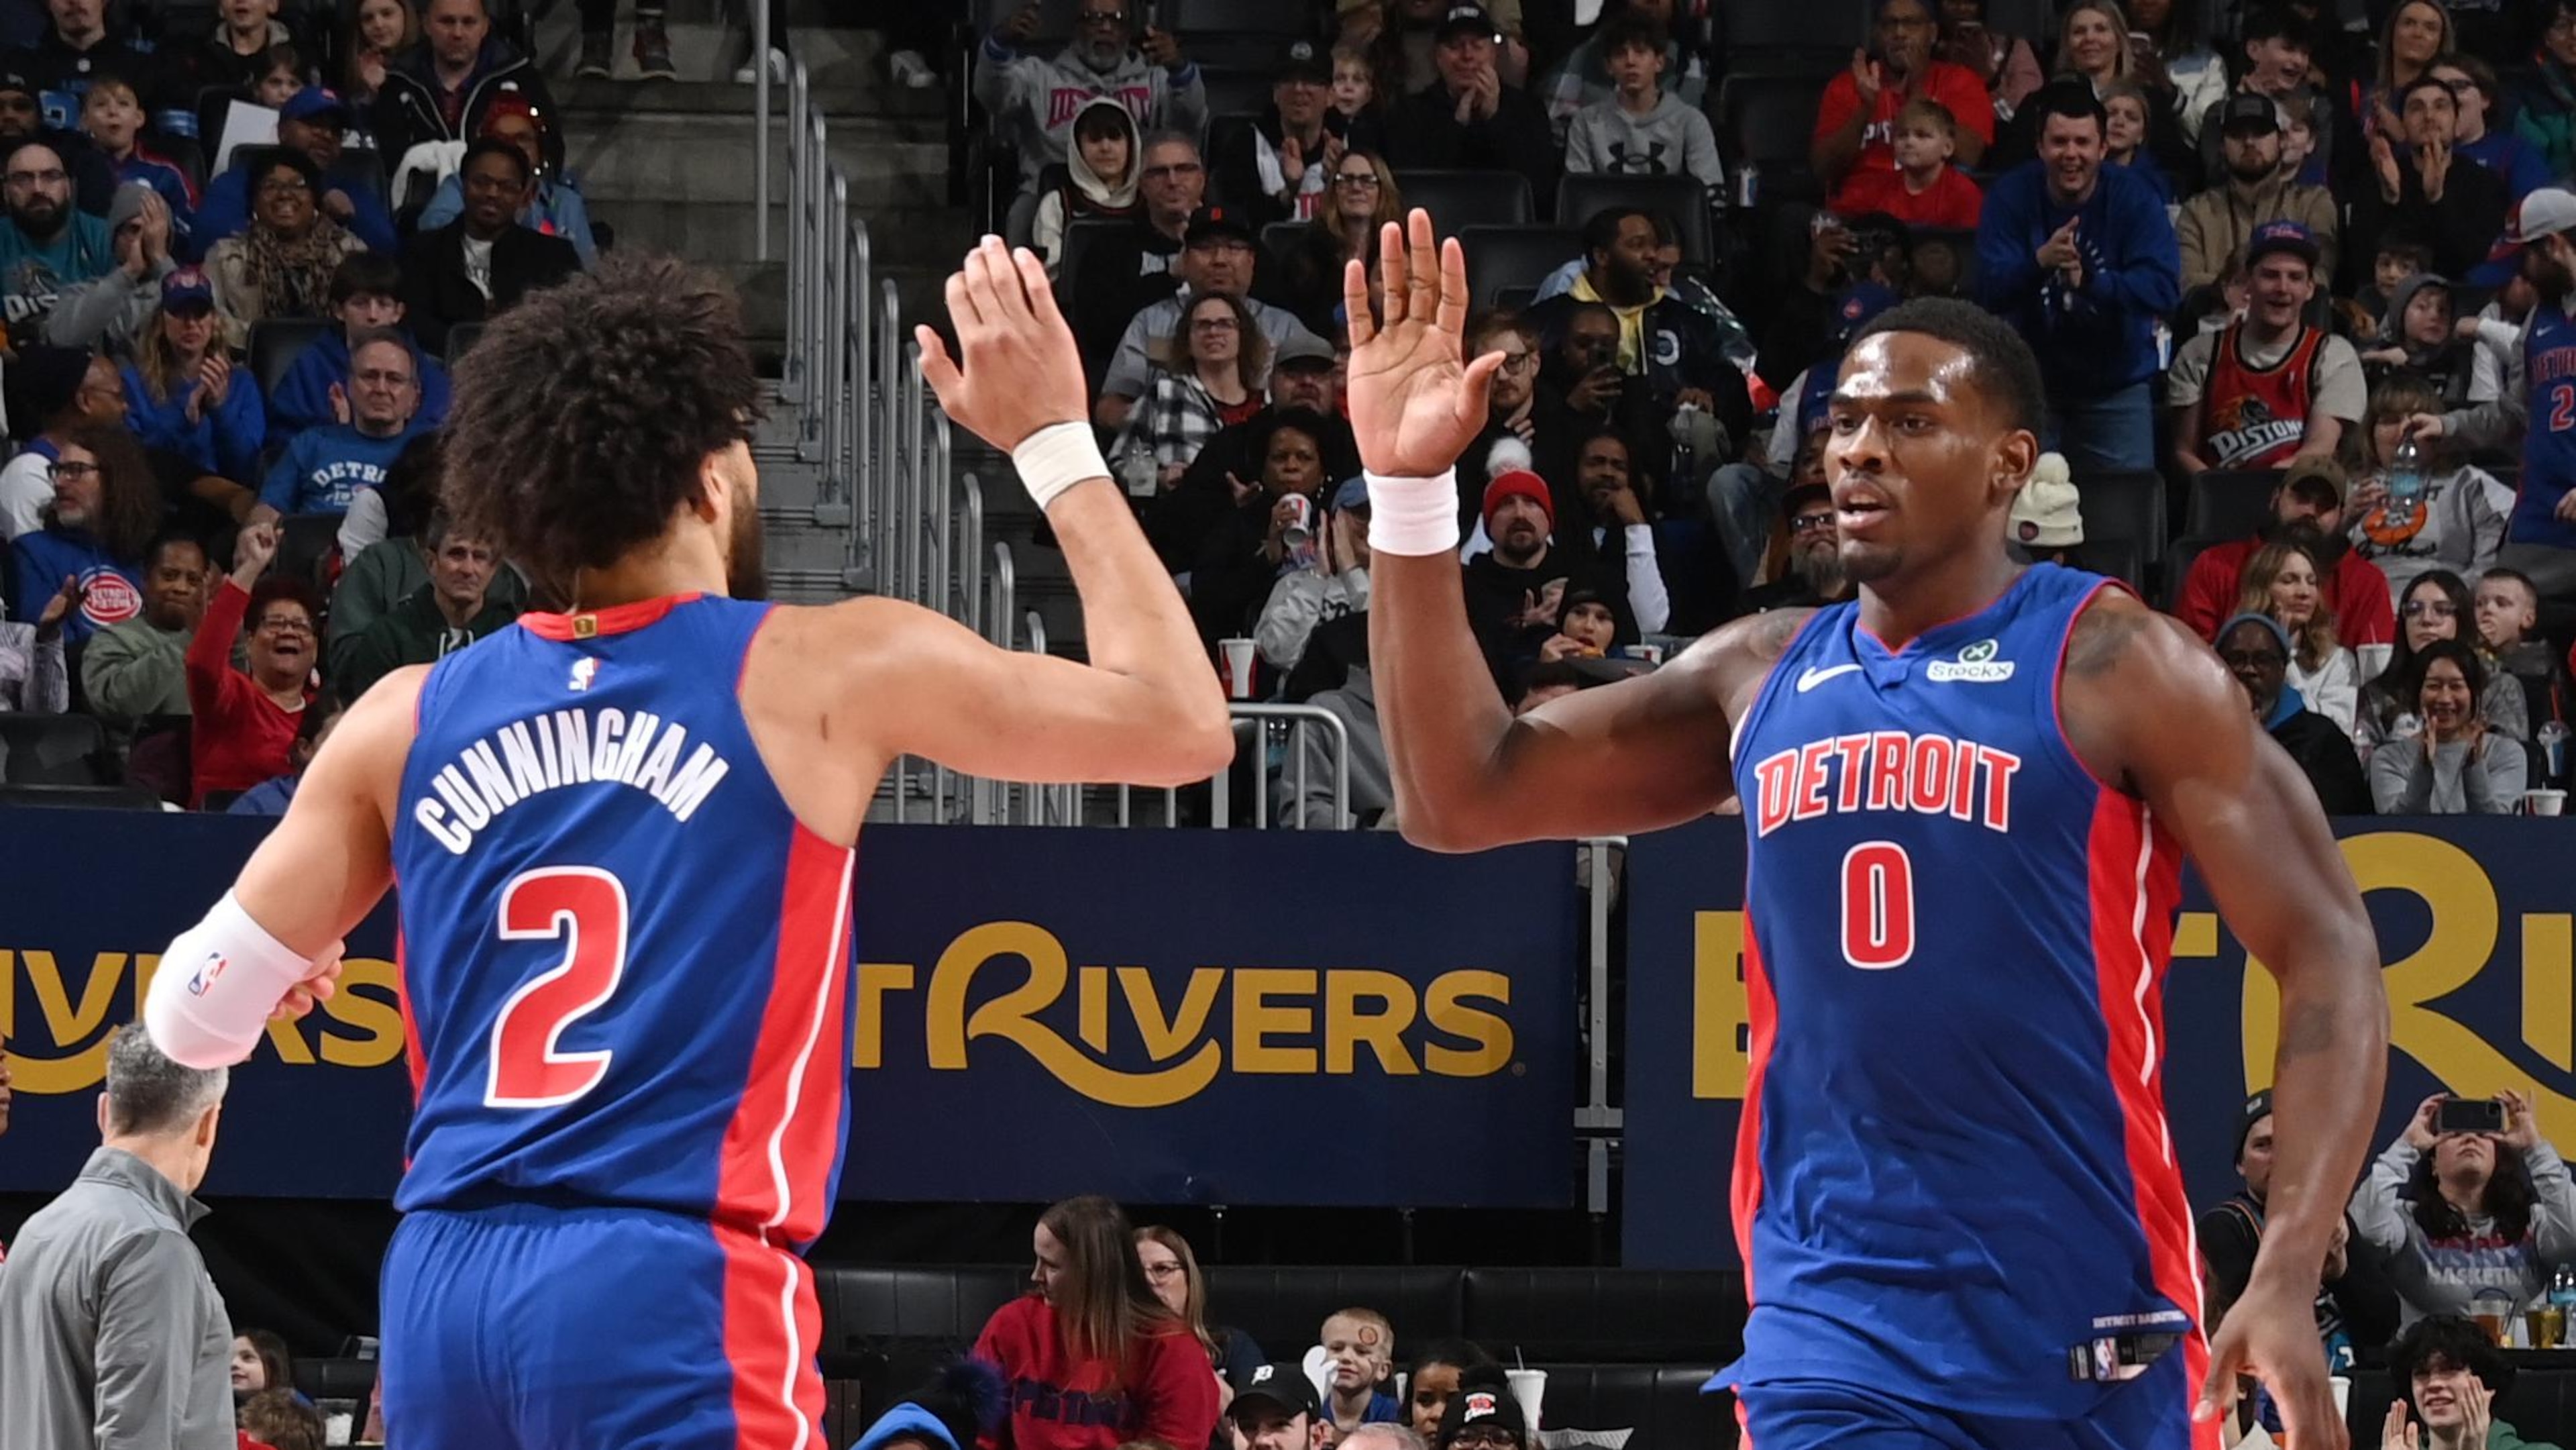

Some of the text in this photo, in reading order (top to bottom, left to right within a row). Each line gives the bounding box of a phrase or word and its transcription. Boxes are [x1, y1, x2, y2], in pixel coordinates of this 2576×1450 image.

[2550, 384, 2575, 432] 2
[416, 708, 729, 855] CUNNINGHAM
[1755, 731, 2021, 837] DETROIT
[1841, 841, 1915, 969] 0
[484, 866, 628, 1108] 2
[926, 920, 1514, 1108] RIVERS
